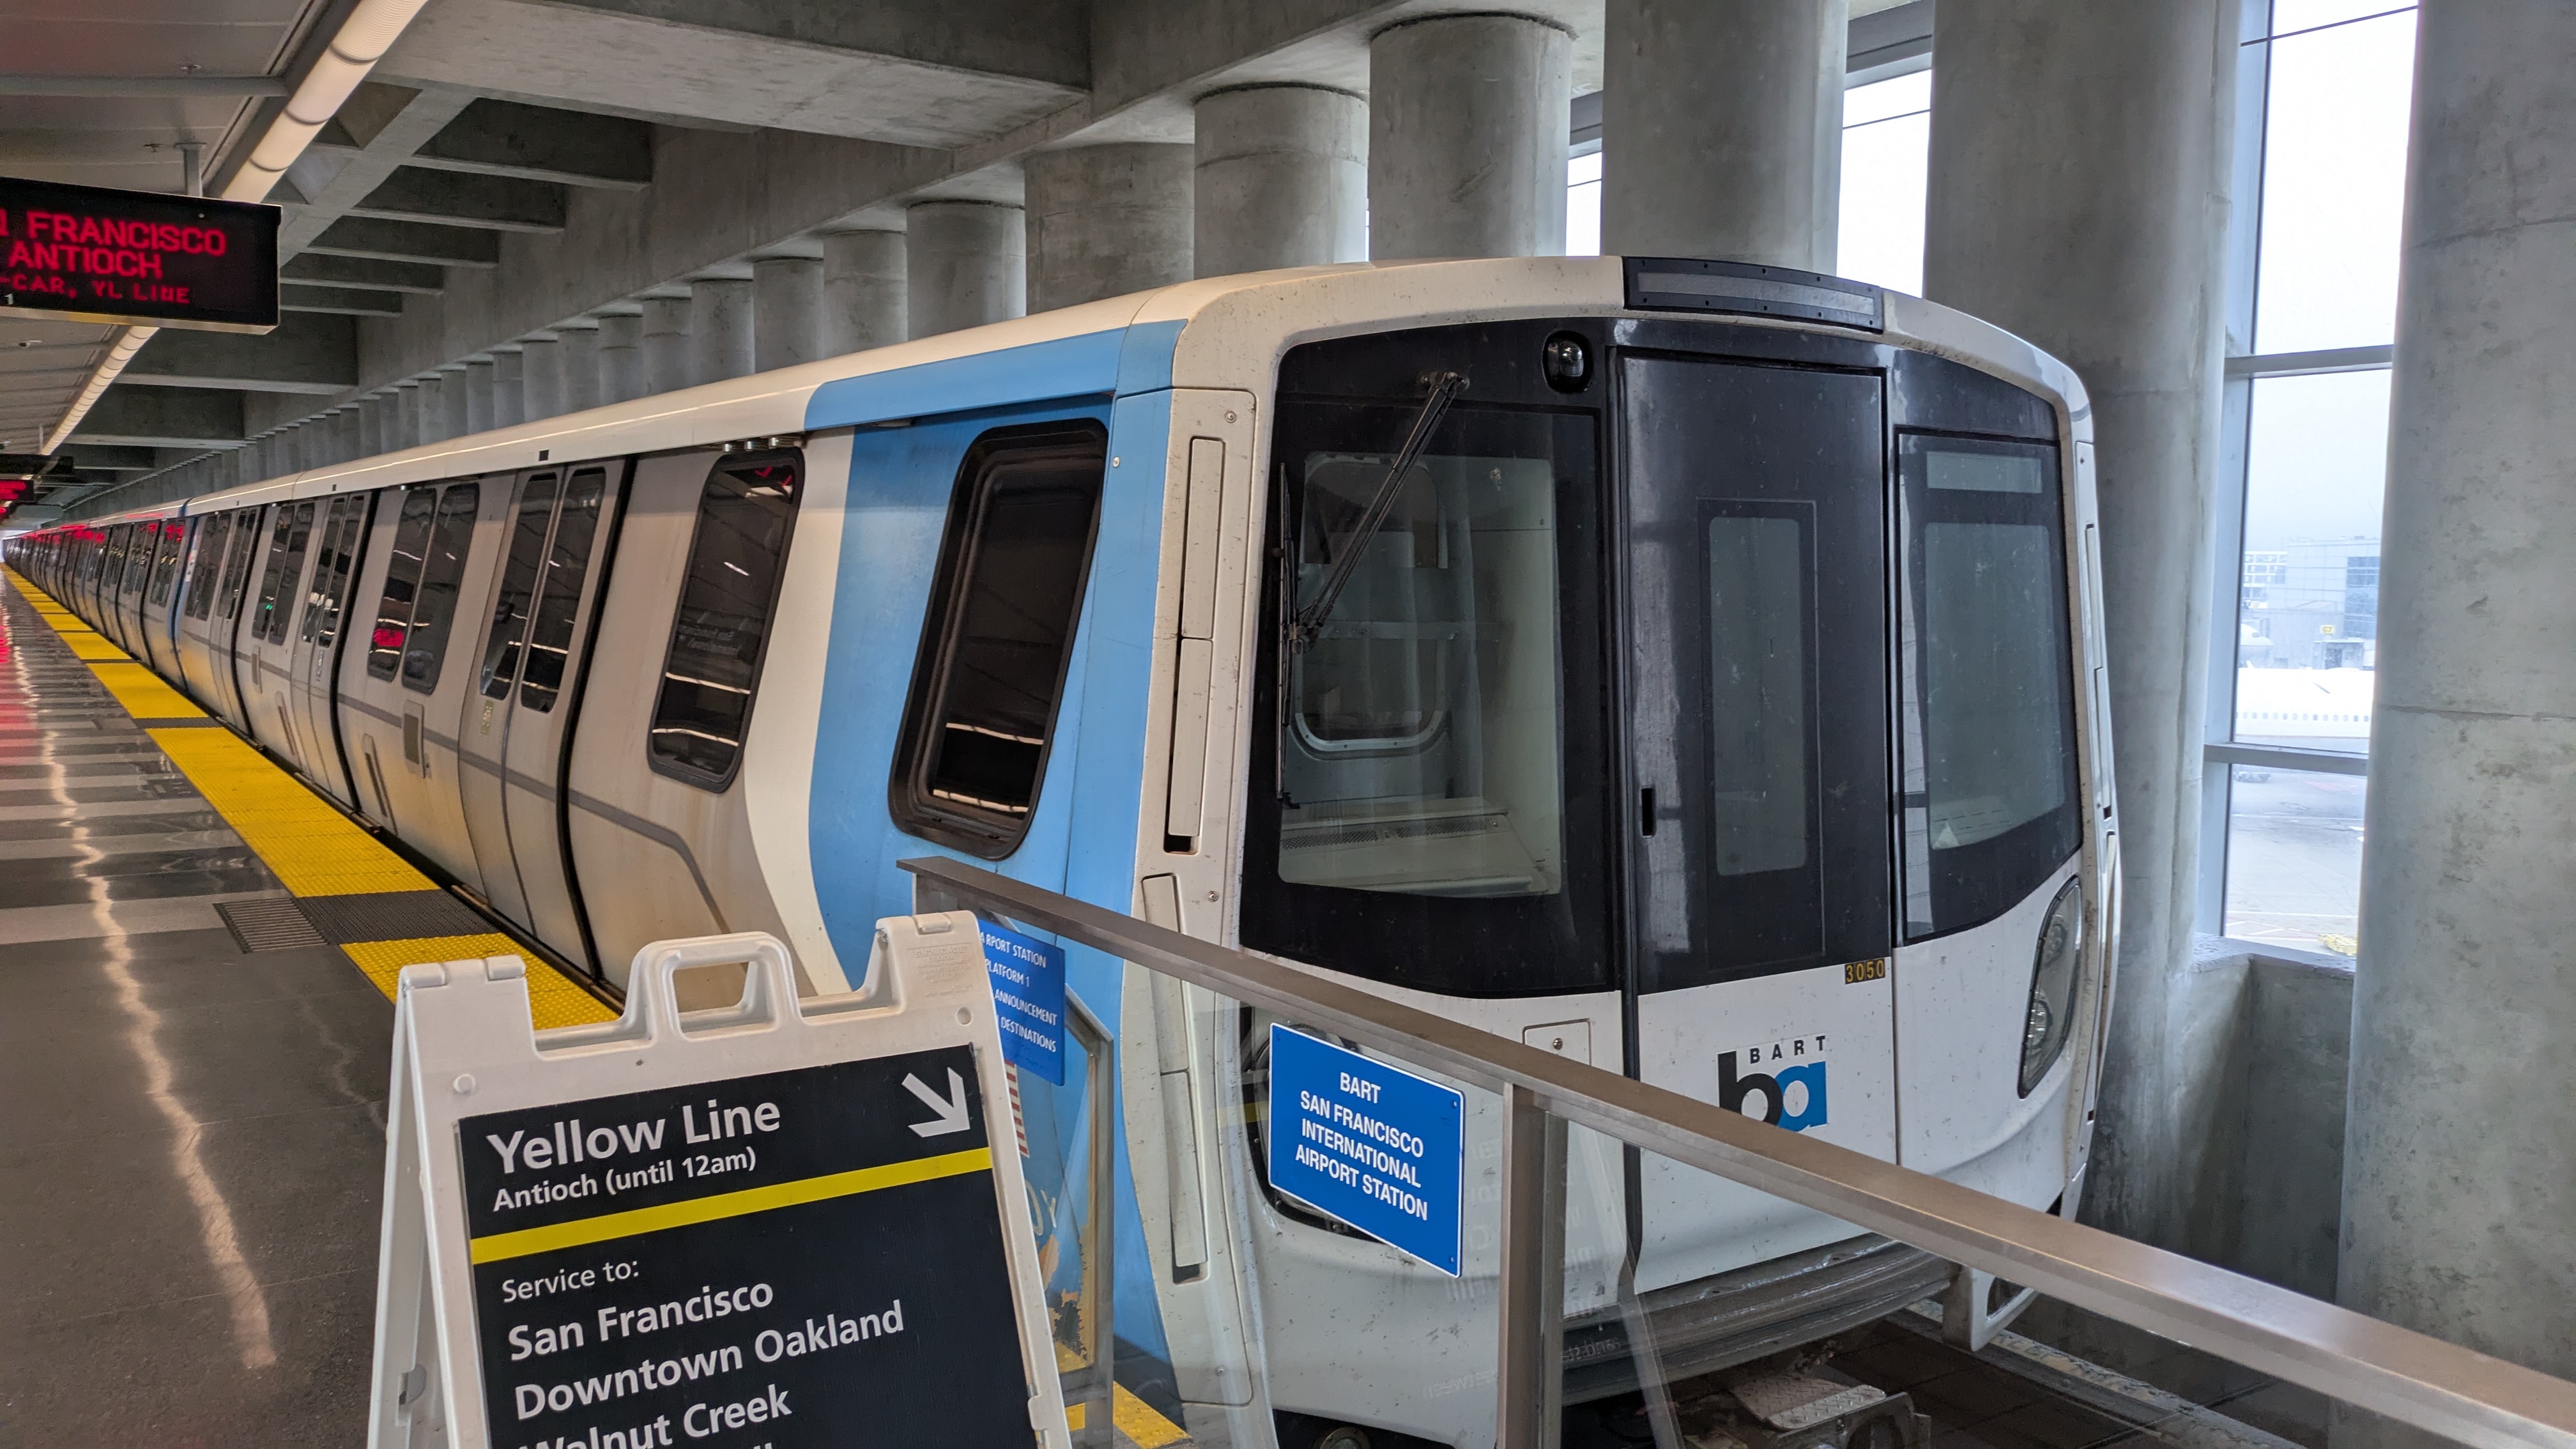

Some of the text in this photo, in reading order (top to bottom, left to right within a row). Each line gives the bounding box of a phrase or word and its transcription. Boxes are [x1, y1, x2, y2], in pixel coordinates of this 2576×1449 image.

[26, 211, 227, 257] FRANCISCO
[8, 240, 164, 280] ANTIOCH
[93, 280, 123, 300] YL
[134, 283, 190, 304] LINE
[985, 958, 1024, 986] PLATFORM
[1025, 976, 1030, 988] 1
[1013, 944, 1046, 969] STATION
[1846, 960, 1885, 983] 3050
[994, 989, 1057, 1026] ANNOUNCEMENT
[1000, 1016, 1057, 1053] DESTINATIONS
[1750, 1035, 1826, 1064] BART
[1340, 1072, 1381, 1104] BART
[486, 1099, 781, 1174] Yellow Line
[1300, 1090, 1330, 1119] SAN
[1334, 1104, 1424, 1158] FRANCISCO
[1301, 1118, 1422, 1188] INTERNATIONAL
[493, 1146, 756, 1212] Antioch (until 12am)
[1295, 1144, 1360, 1188] AIRPORT
[1362, 1174, 1428, 1221] STATION
[502, 1260, 640, 1303] Service to:
[509, 1283, 774, 1361] San Francisco
[515, 1300, 904, 1420] Downtown Oakland
[519, 1383, 792, 1449] lnut Creek
